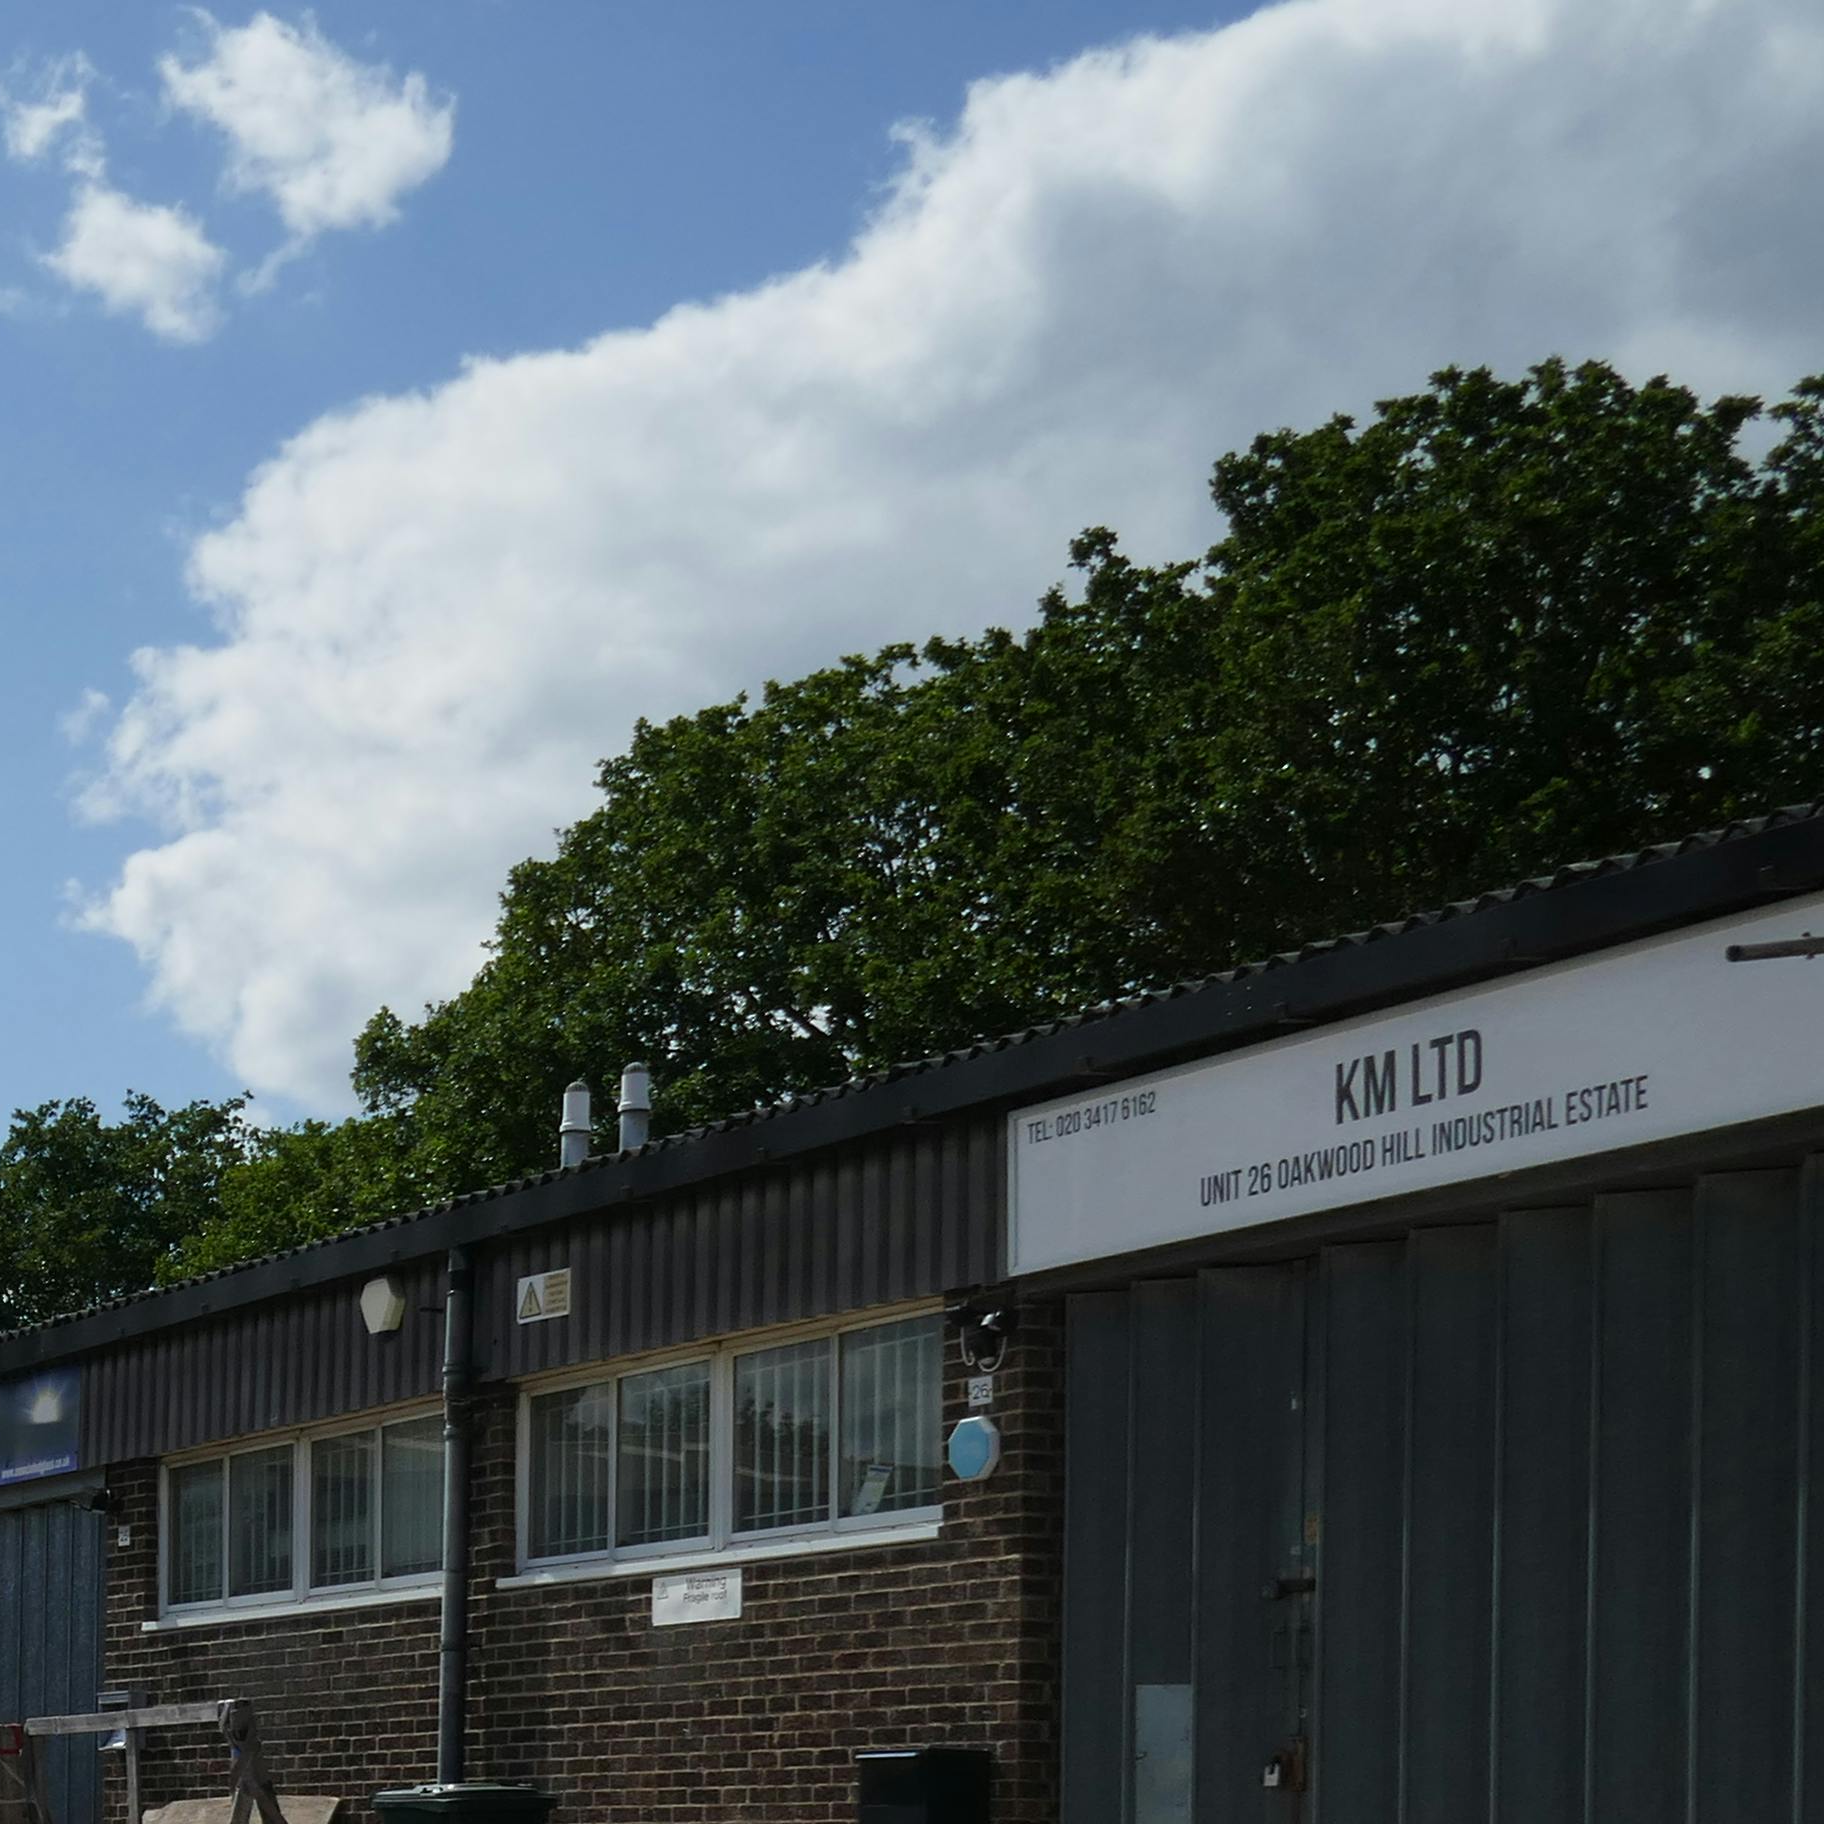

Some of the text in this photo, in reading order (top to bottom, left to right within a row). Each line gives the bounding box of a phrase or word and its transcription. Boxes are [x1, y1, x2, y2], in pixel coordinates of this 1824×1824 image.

[1335, 1029, 1482, 1125] KM LTD
[1056, 1111, 1081, 1137] 020
[1084, 1101, 1117, 1129] 3417
[1121, 1091, 1156, 1120] 6162
[1200, 1075, 1649, 1207] UNIT 26 OAKWOOD HILL INDUSTRIAL ESTATE
[973, 1383, 990, 1400] 26
[683, 1591, 710, 1604] Fragile
[685, 1577, 727, 1591] Warning
